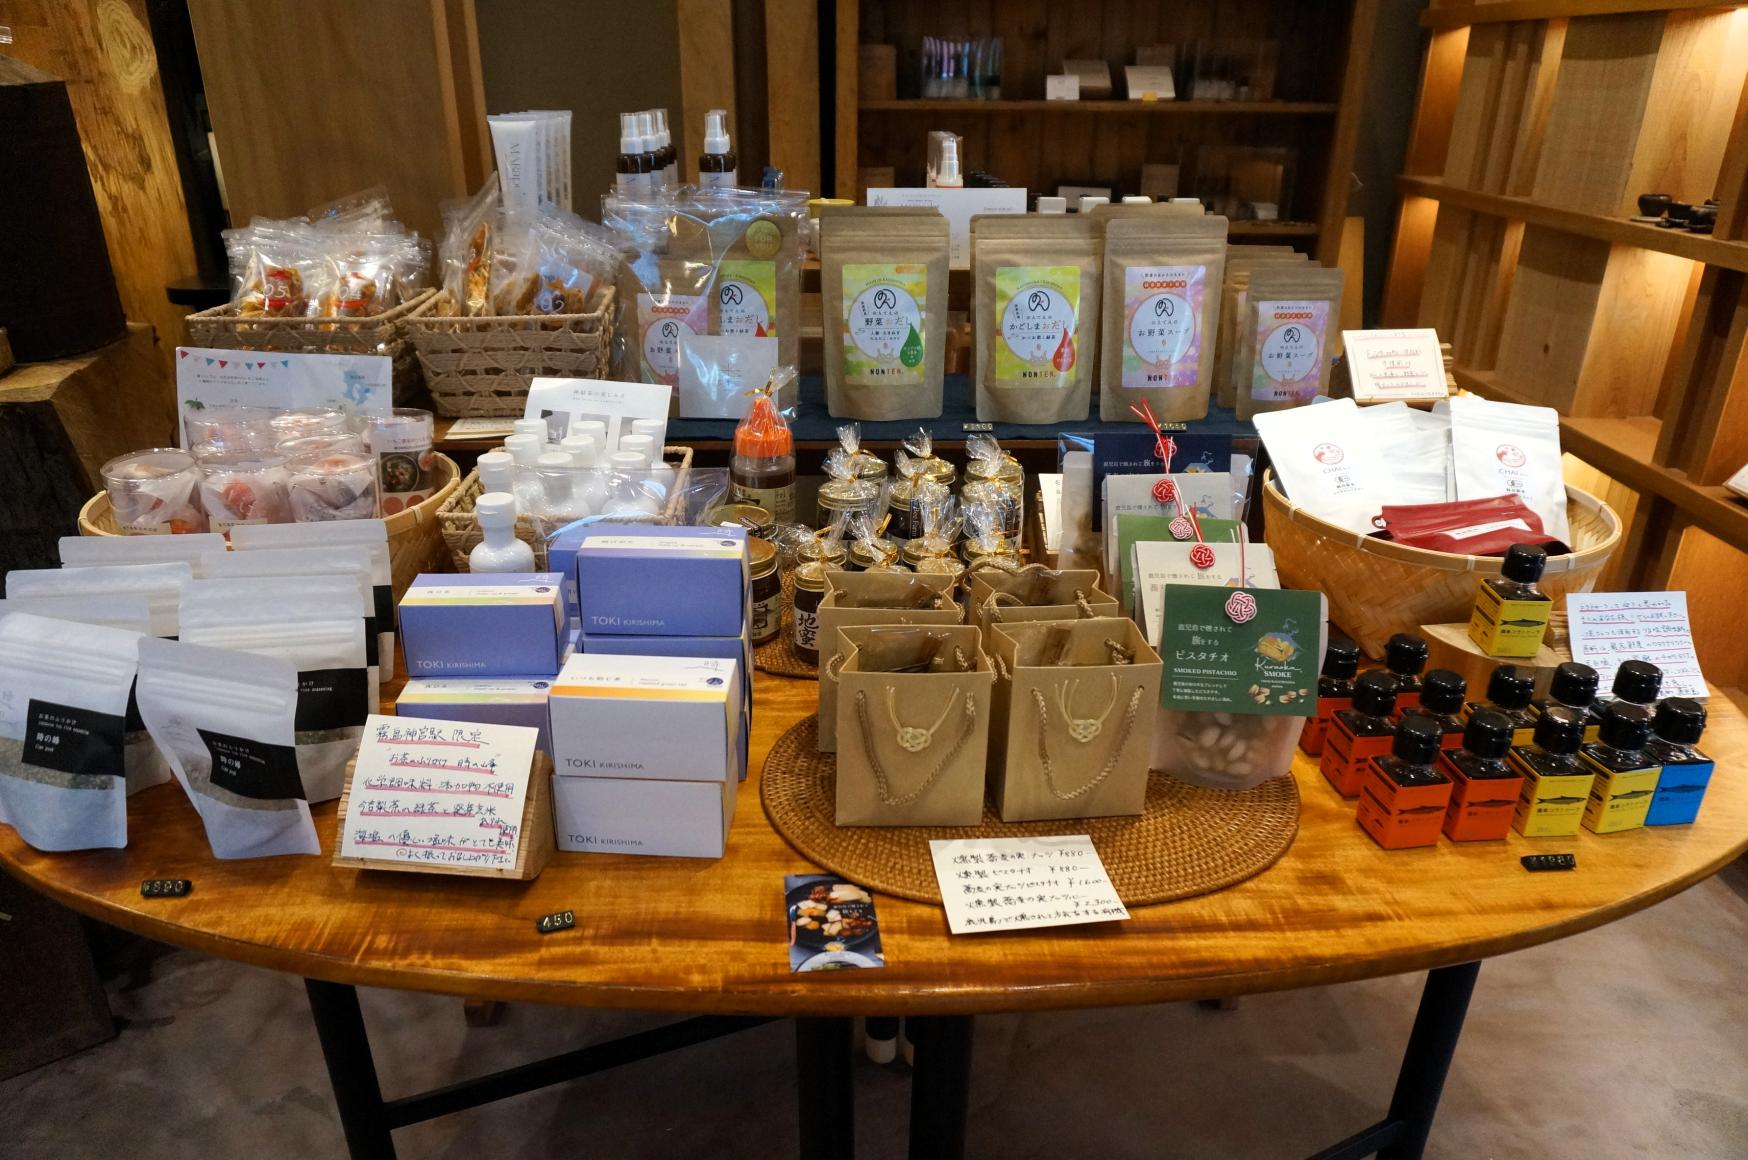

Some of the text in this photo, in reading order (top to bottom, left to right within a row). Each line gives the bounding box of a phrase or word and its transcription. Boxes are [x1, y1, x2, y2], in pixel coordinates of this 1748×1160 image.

[591, 616, 621, 626] TOKI
[1175, 650, 1230, 663] ピスタチオ
[416, 660, 486, 669] TOKI KIRISHIMA
[1173, 667, 1238, 677] SMOKED PISTACHIO
[565, 758, 645, 770] TOKI KIRISHIMA
[568, 834, 643, 846] TOKI KIRISHIMA
